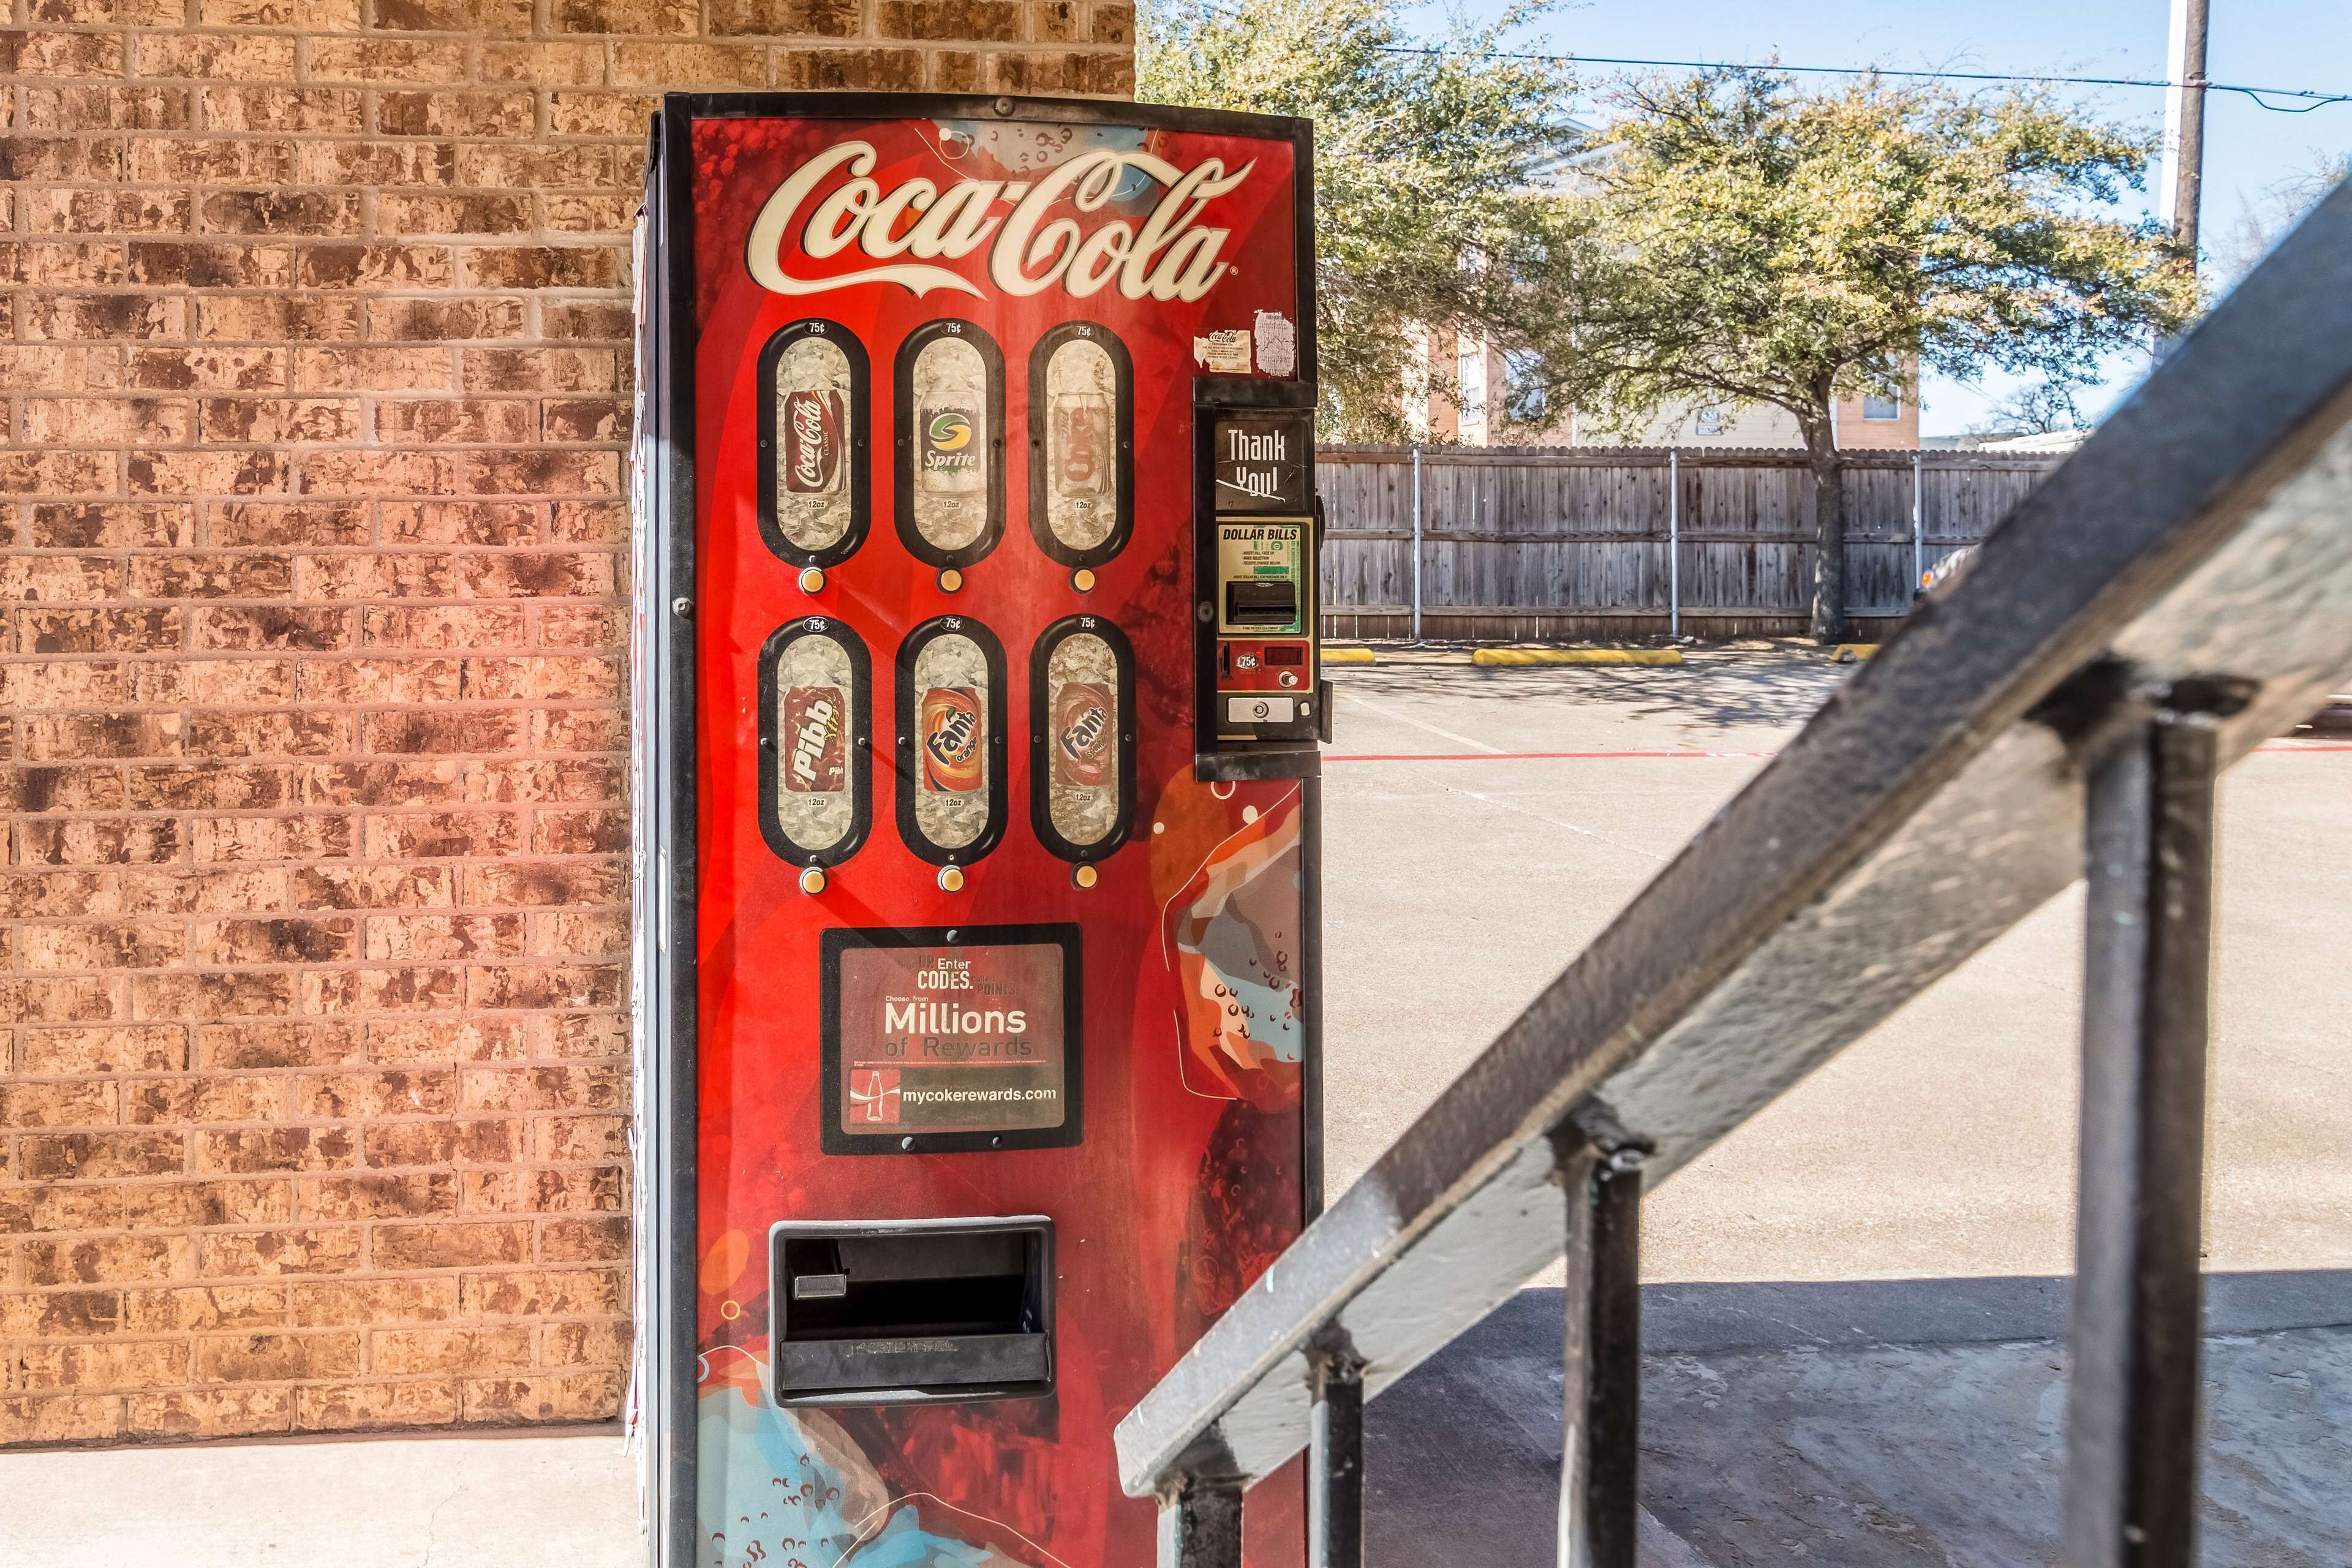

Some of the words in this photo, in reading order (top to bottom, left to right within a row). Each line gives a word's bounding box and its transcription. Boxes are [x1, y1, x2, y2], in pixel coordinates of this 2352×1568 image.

[744, 140, 1257, 303] Coca-Cola
[809, 322, 824, 333] 75¢
[946, 323, 961, 333] 75¢
[1077, 326, 1091, 336] 75¢
[794, 396, 823, 487] Coca-Cola
[1228, 429, 1285, 461] Thank
[925, 450, 976, 470] Sprite
[808, 500, 825, 509] 12oz
[1076, 501, 1092, 510] 12oz
[1223, 529, 1264, 540] DOLLAR
[1267, 529, 1297, 540] BILLS
[809, 619, 825, 630] 75¢
[946, 618, 961, 629] 75¢
[1081, 617, 1095, 628] 75¢
[1242, 657, 1256, 666] 75¢
[927, 711, 977, 765] Fanta
[1060, 707, 1107, 760] Fanta
[793, 700, 833, 782] Pibb
[956, 736, 978, 761] orange
[808, 797, 825, 807] 12oz
[944, 798, 962, 807] 12oz
[1075, 793, 1091, 802] 12oz
[938, 958, 971, 970] Enter
[918, 970, 974, 989] CODES.
[885, 1003, 1027, 1034] Millions
[884, 1036, 908, 1057] of
[924, 1035, 1033, 1057] Rewards
[903, 1088, 1057, 1105] mycokerewards.com
